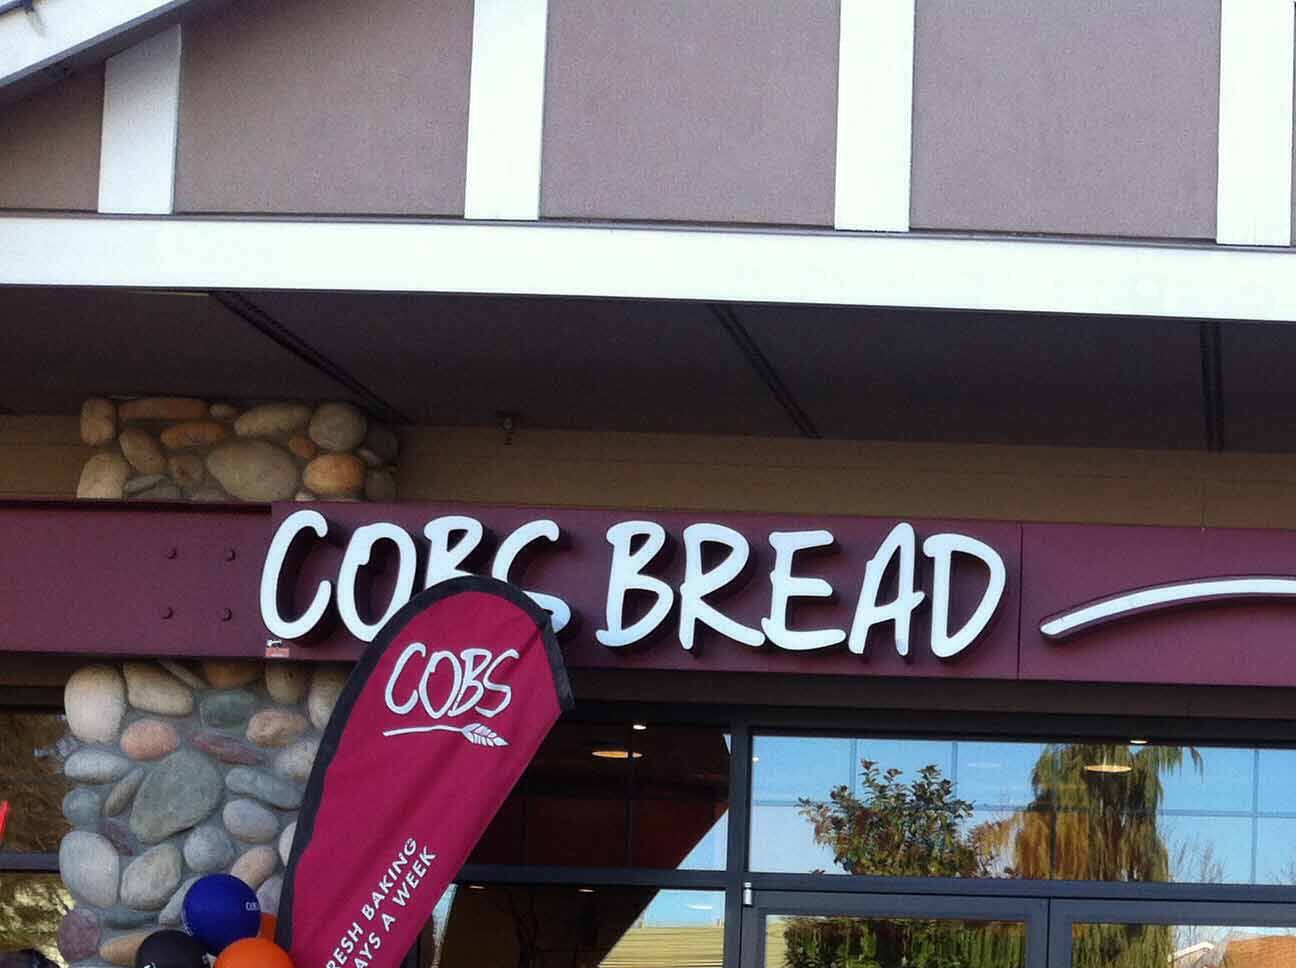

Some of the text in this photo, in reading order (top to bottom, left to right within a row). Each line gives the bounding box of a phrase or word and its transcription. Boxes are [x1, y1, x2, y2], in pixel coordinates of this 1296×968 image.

[597, 520, 1006, 658] BREAD
[384, 642, 520, 719] COBS
[361, 838, 417, 920] BAKING
[381, 913, 396, 931] A
[392, 846, 436, 906] WEEK
